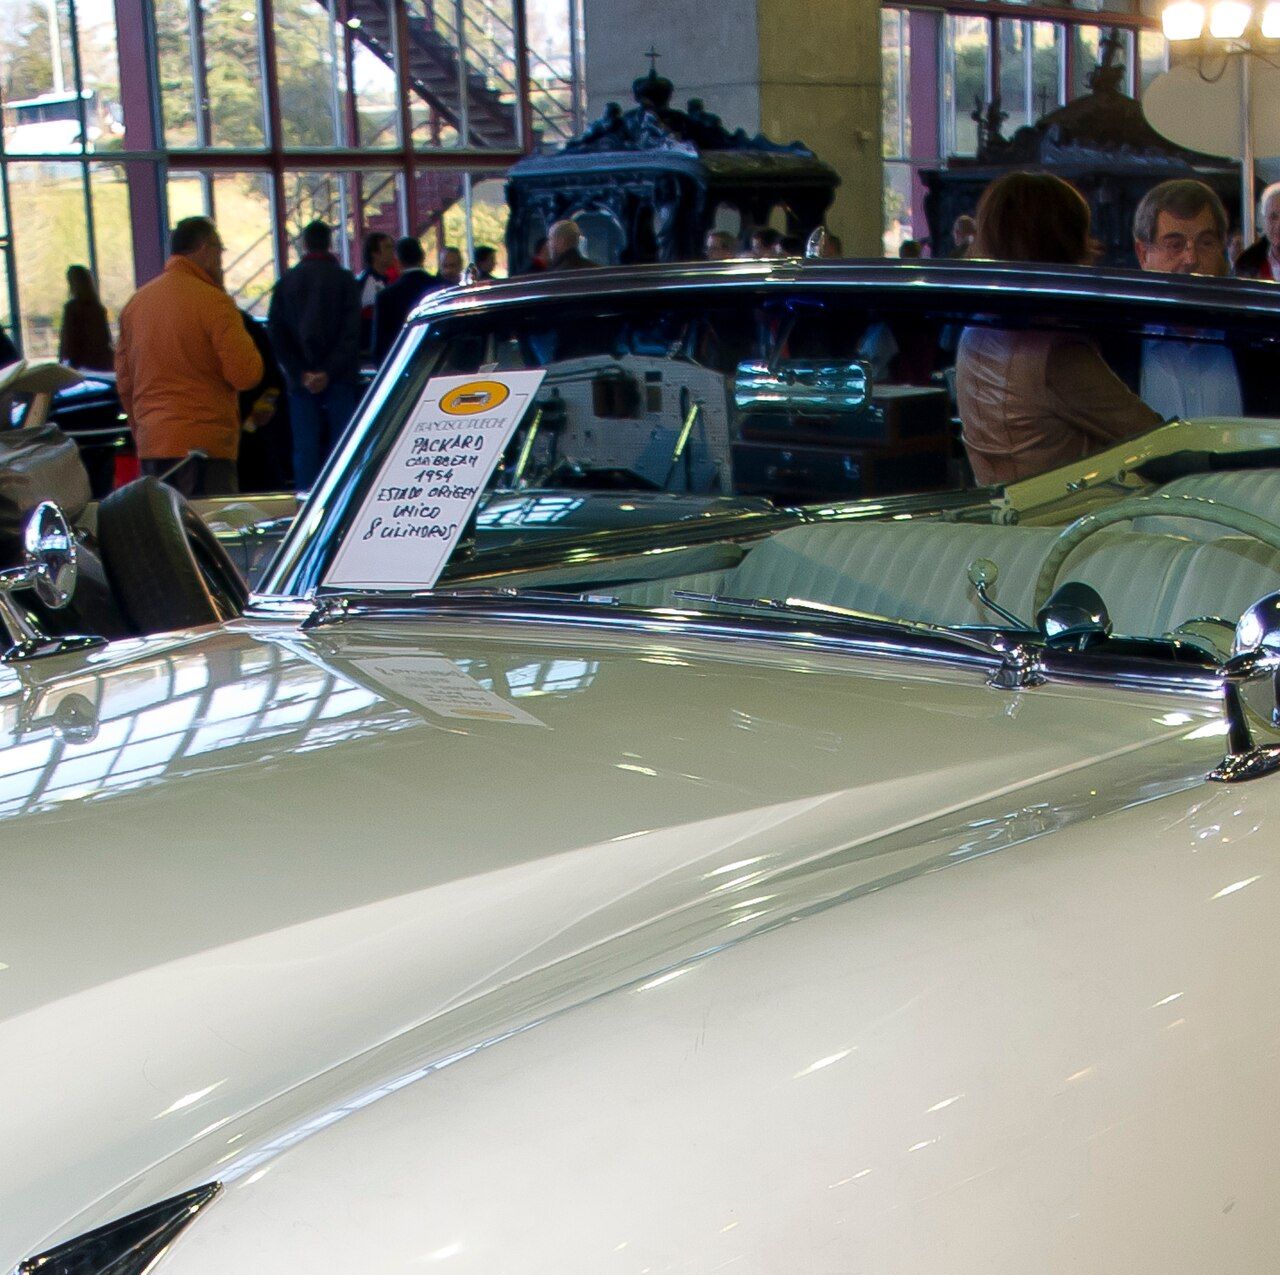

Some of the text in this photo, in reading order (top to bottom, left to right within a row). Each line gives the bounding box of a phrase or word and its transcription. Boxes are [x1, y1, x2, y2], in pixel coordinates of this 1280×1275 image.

[411, 434, 484, 454] PACKARD
[414, 468, 454, 483] 1954
[377, 486, 423, 501] ESTADO
[363, 517, 382, 540] 8
